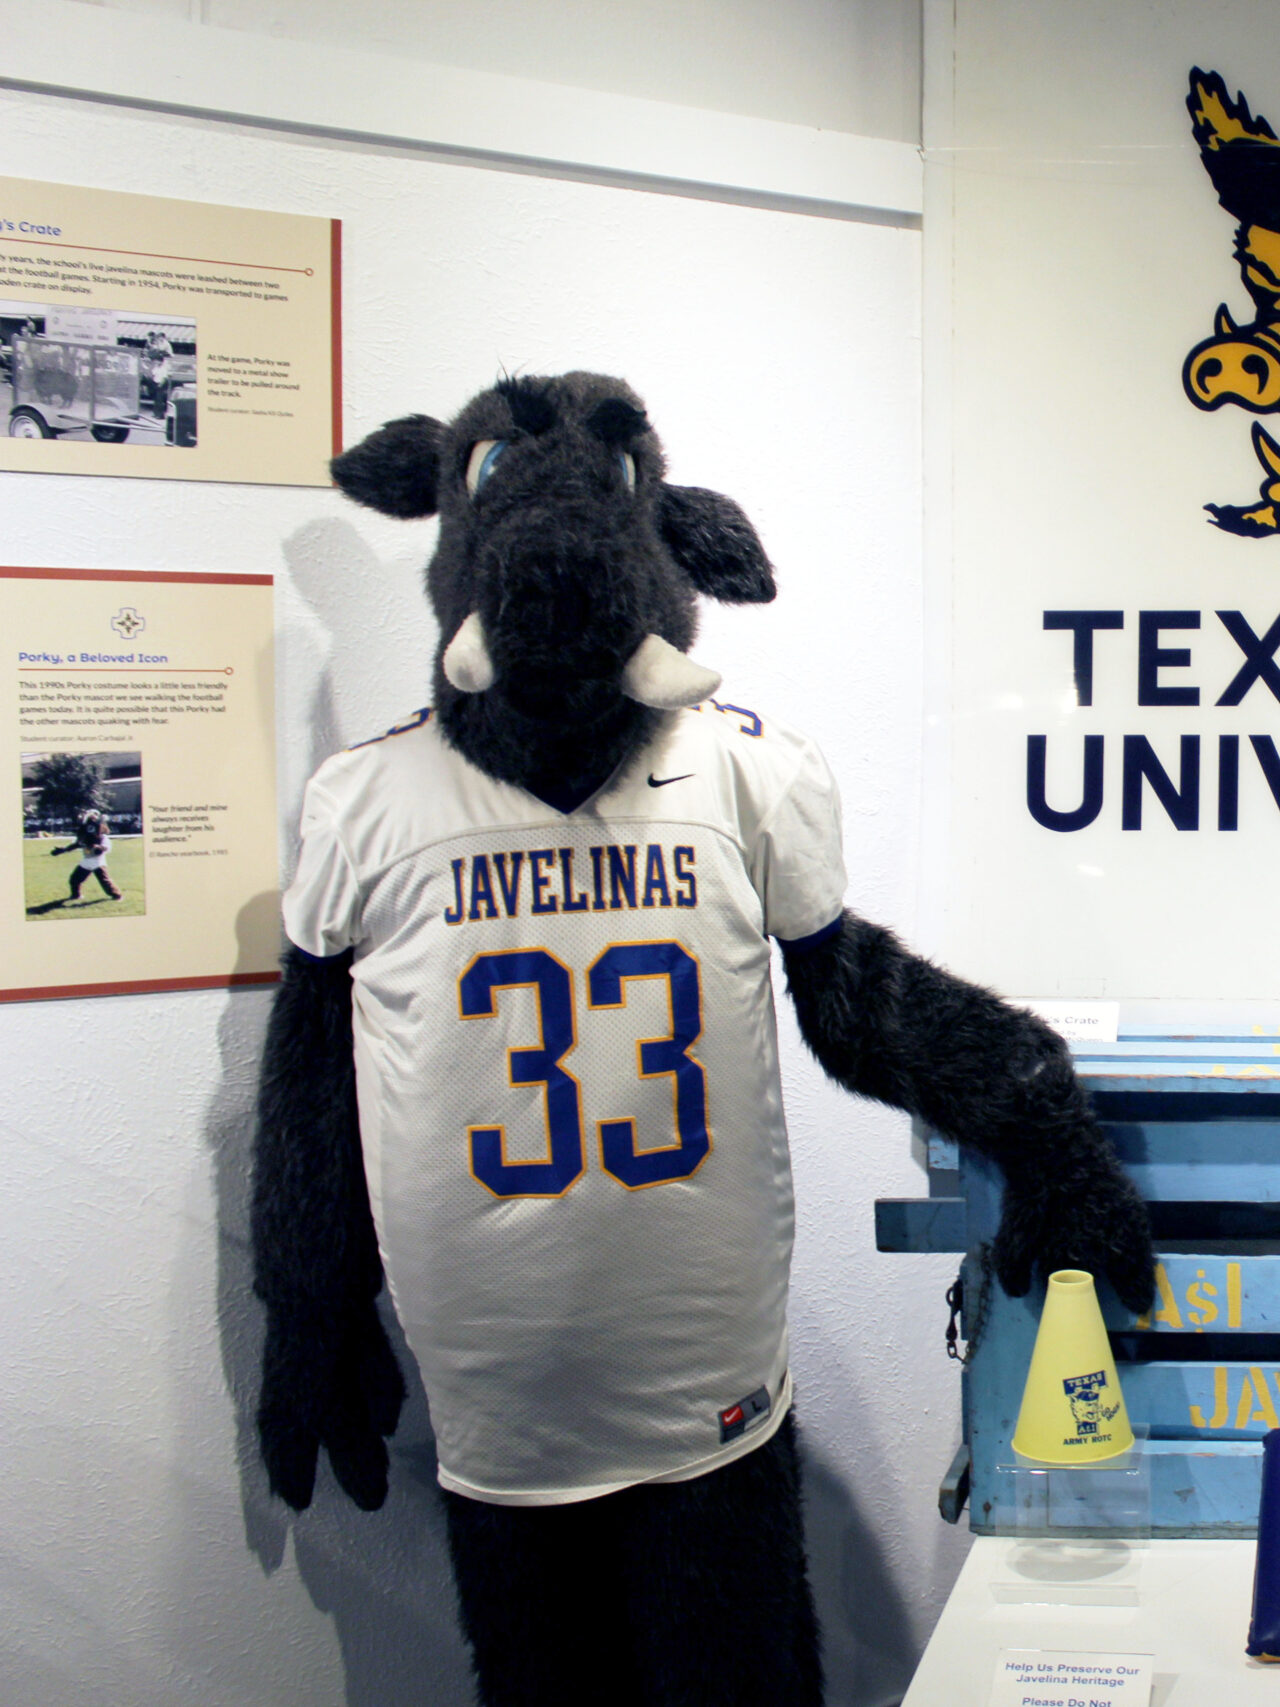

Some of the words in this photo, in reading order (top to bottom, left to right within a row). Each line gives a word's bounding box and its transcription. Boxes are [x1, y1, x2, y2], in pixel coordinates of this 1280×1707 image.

[19, 221, 62, 236] Crate
[37, 257, 50, 265] the
[53, 259, 87, 269] school's
[89, 262, 104, 271] live
[106, 265, 137, 275] javelina
[141, 269, 173, 278] mascots
[198, 274, 227, 284] leashed
[230, 277, 262, 288] between
[265, 281, 280, 289] two
[9, 267, 23, 275] the
[25, 269, 58, 278] football
[93, 275, 125, 286] Starting
[163, 282, 186, 291] Porky
[206, 286, 252, 298] transported
[264, 293, 288, 301] games
[24, 281, 46, 290] crate
[61, 284, 92, 294] display.
[254, 357, 274, 367] Porky
[249, 369, 268, 377] metal
[251, 381, 272, 389] pulled
[275, 382, 300, 390] around
[19, 652, 63, 664] Porky,
[67, 654, 76, 662] a
[80, 653, 134, 662] Beloved
[138, 653, 168, 662] Icon
[19, 681, 37, 689] This
[67, 681, 91, 689] Porky
[198, 682, 228, 690] friendly
[57, 694, 81, 702] Porky
[145, 694, 175, 702] walking
[444, 844, 698, 926] JAVELINAS
[1065, 1016, 1099, 1024] Crate
[457, 938, 715, 1200] 33
[1067, 1373, 1103, 1387] TEXAS
[1063, 1437, 1088, 1445] ARMY
[1092, 1434, 1112, 1443] ROTC
[1005, 1662, 1033, 1673] Help
[1037, 1663, 1053, 1672] Us
[1057, 1664, 1112, 1674] Preserve
[1116, 1666, 1140, 1675] Our
[1016, 1674, 1068, 1684] Javelina
[1072, 1676, 1125, 1688] Heritage
[1022, 1697, 1064, 1707] Please
[1068, 1699, 1085, 1707] Do
[1089, 1699, 1112, 1707] Not
